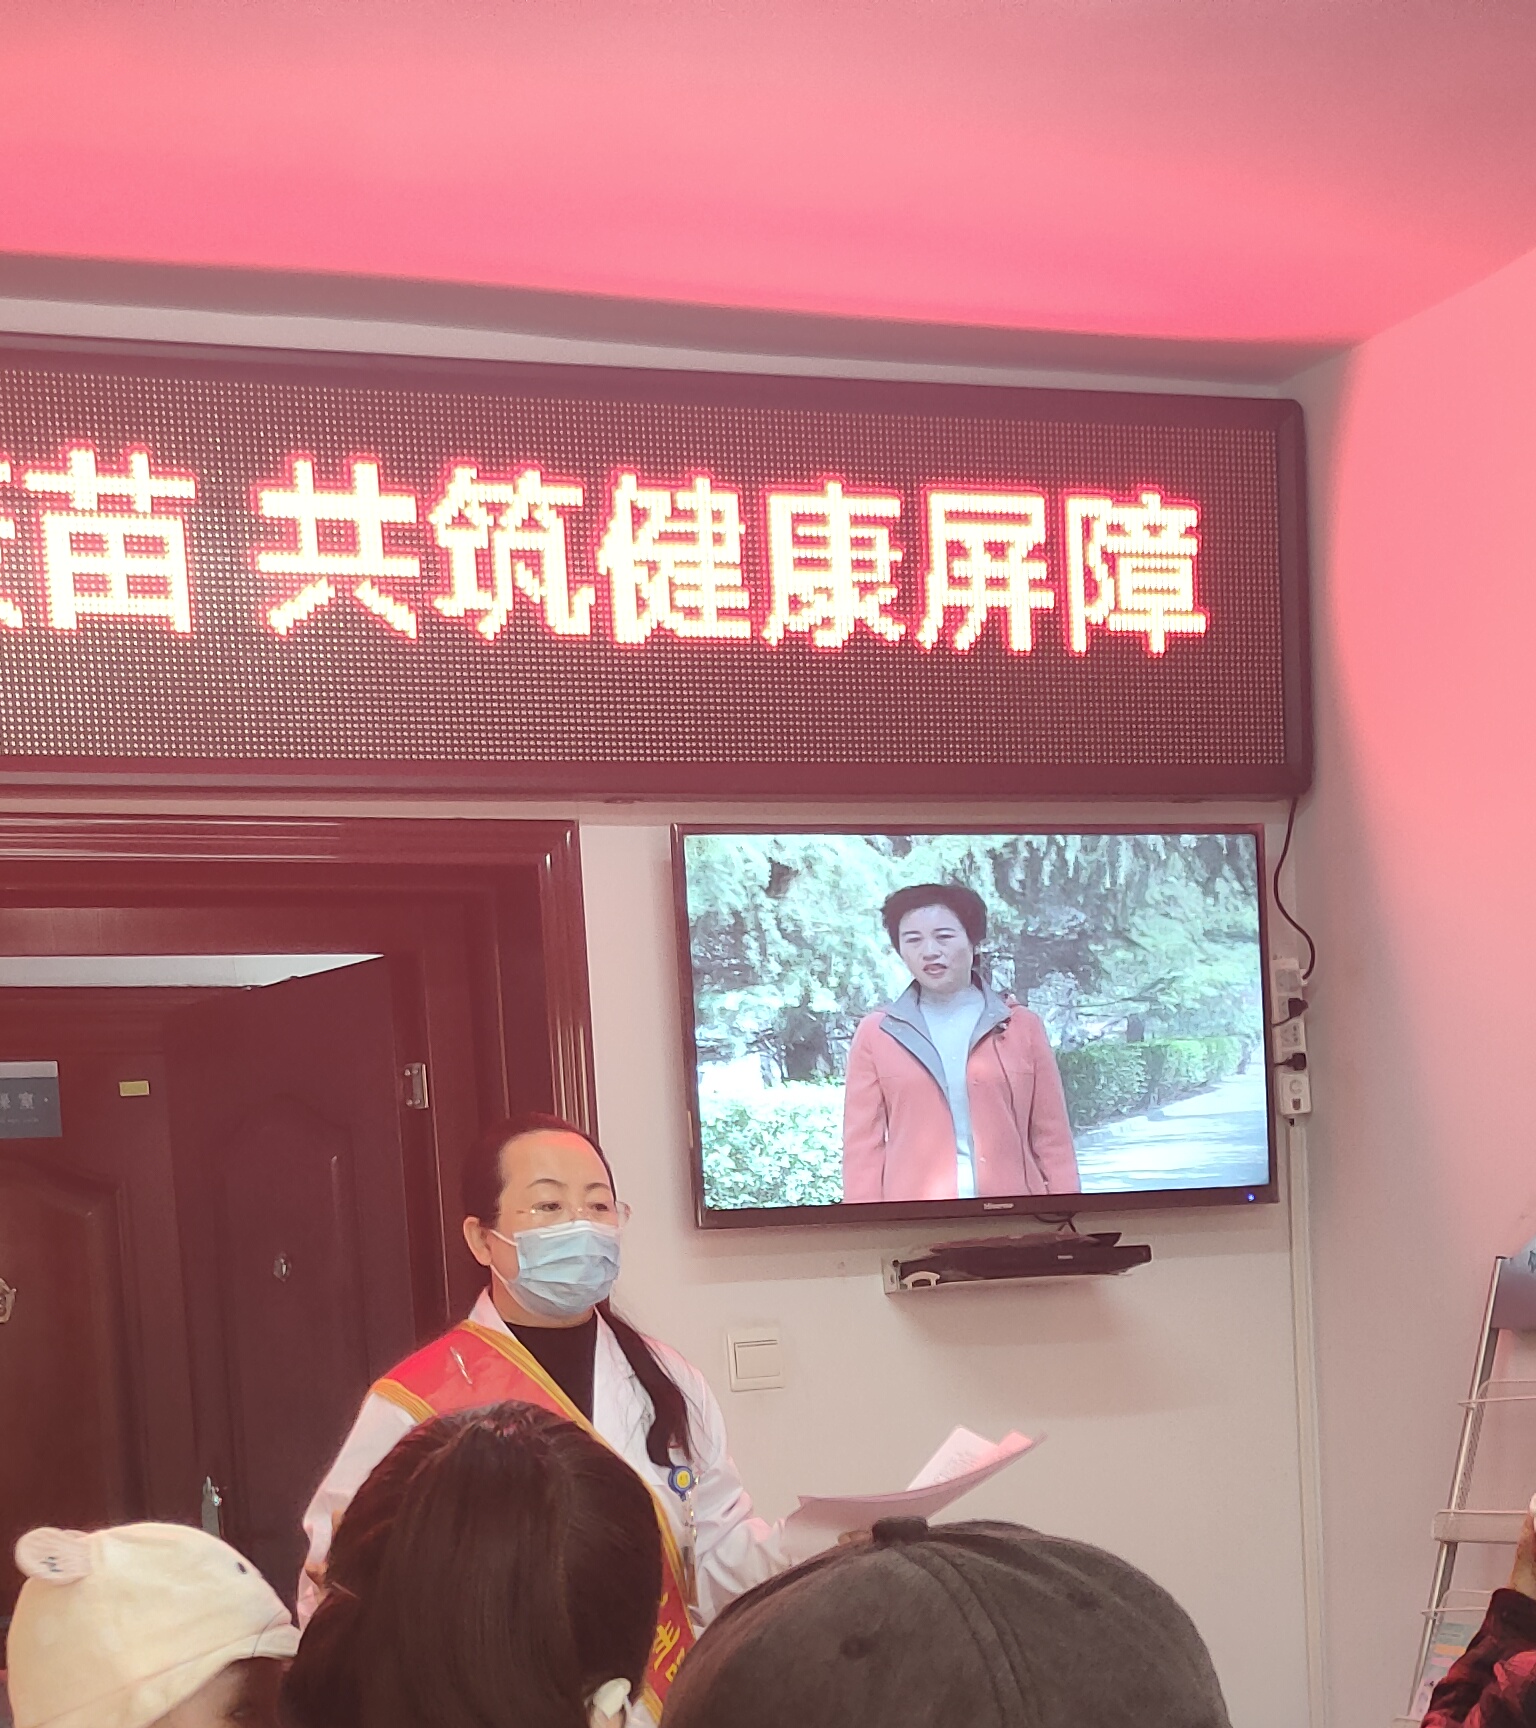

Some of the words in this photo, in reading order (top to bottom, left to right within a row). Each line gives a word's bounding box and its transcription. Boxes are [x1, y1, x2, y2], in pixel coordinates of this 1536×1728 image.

[254, 453, 1214, 656] 共筑健康屏障
